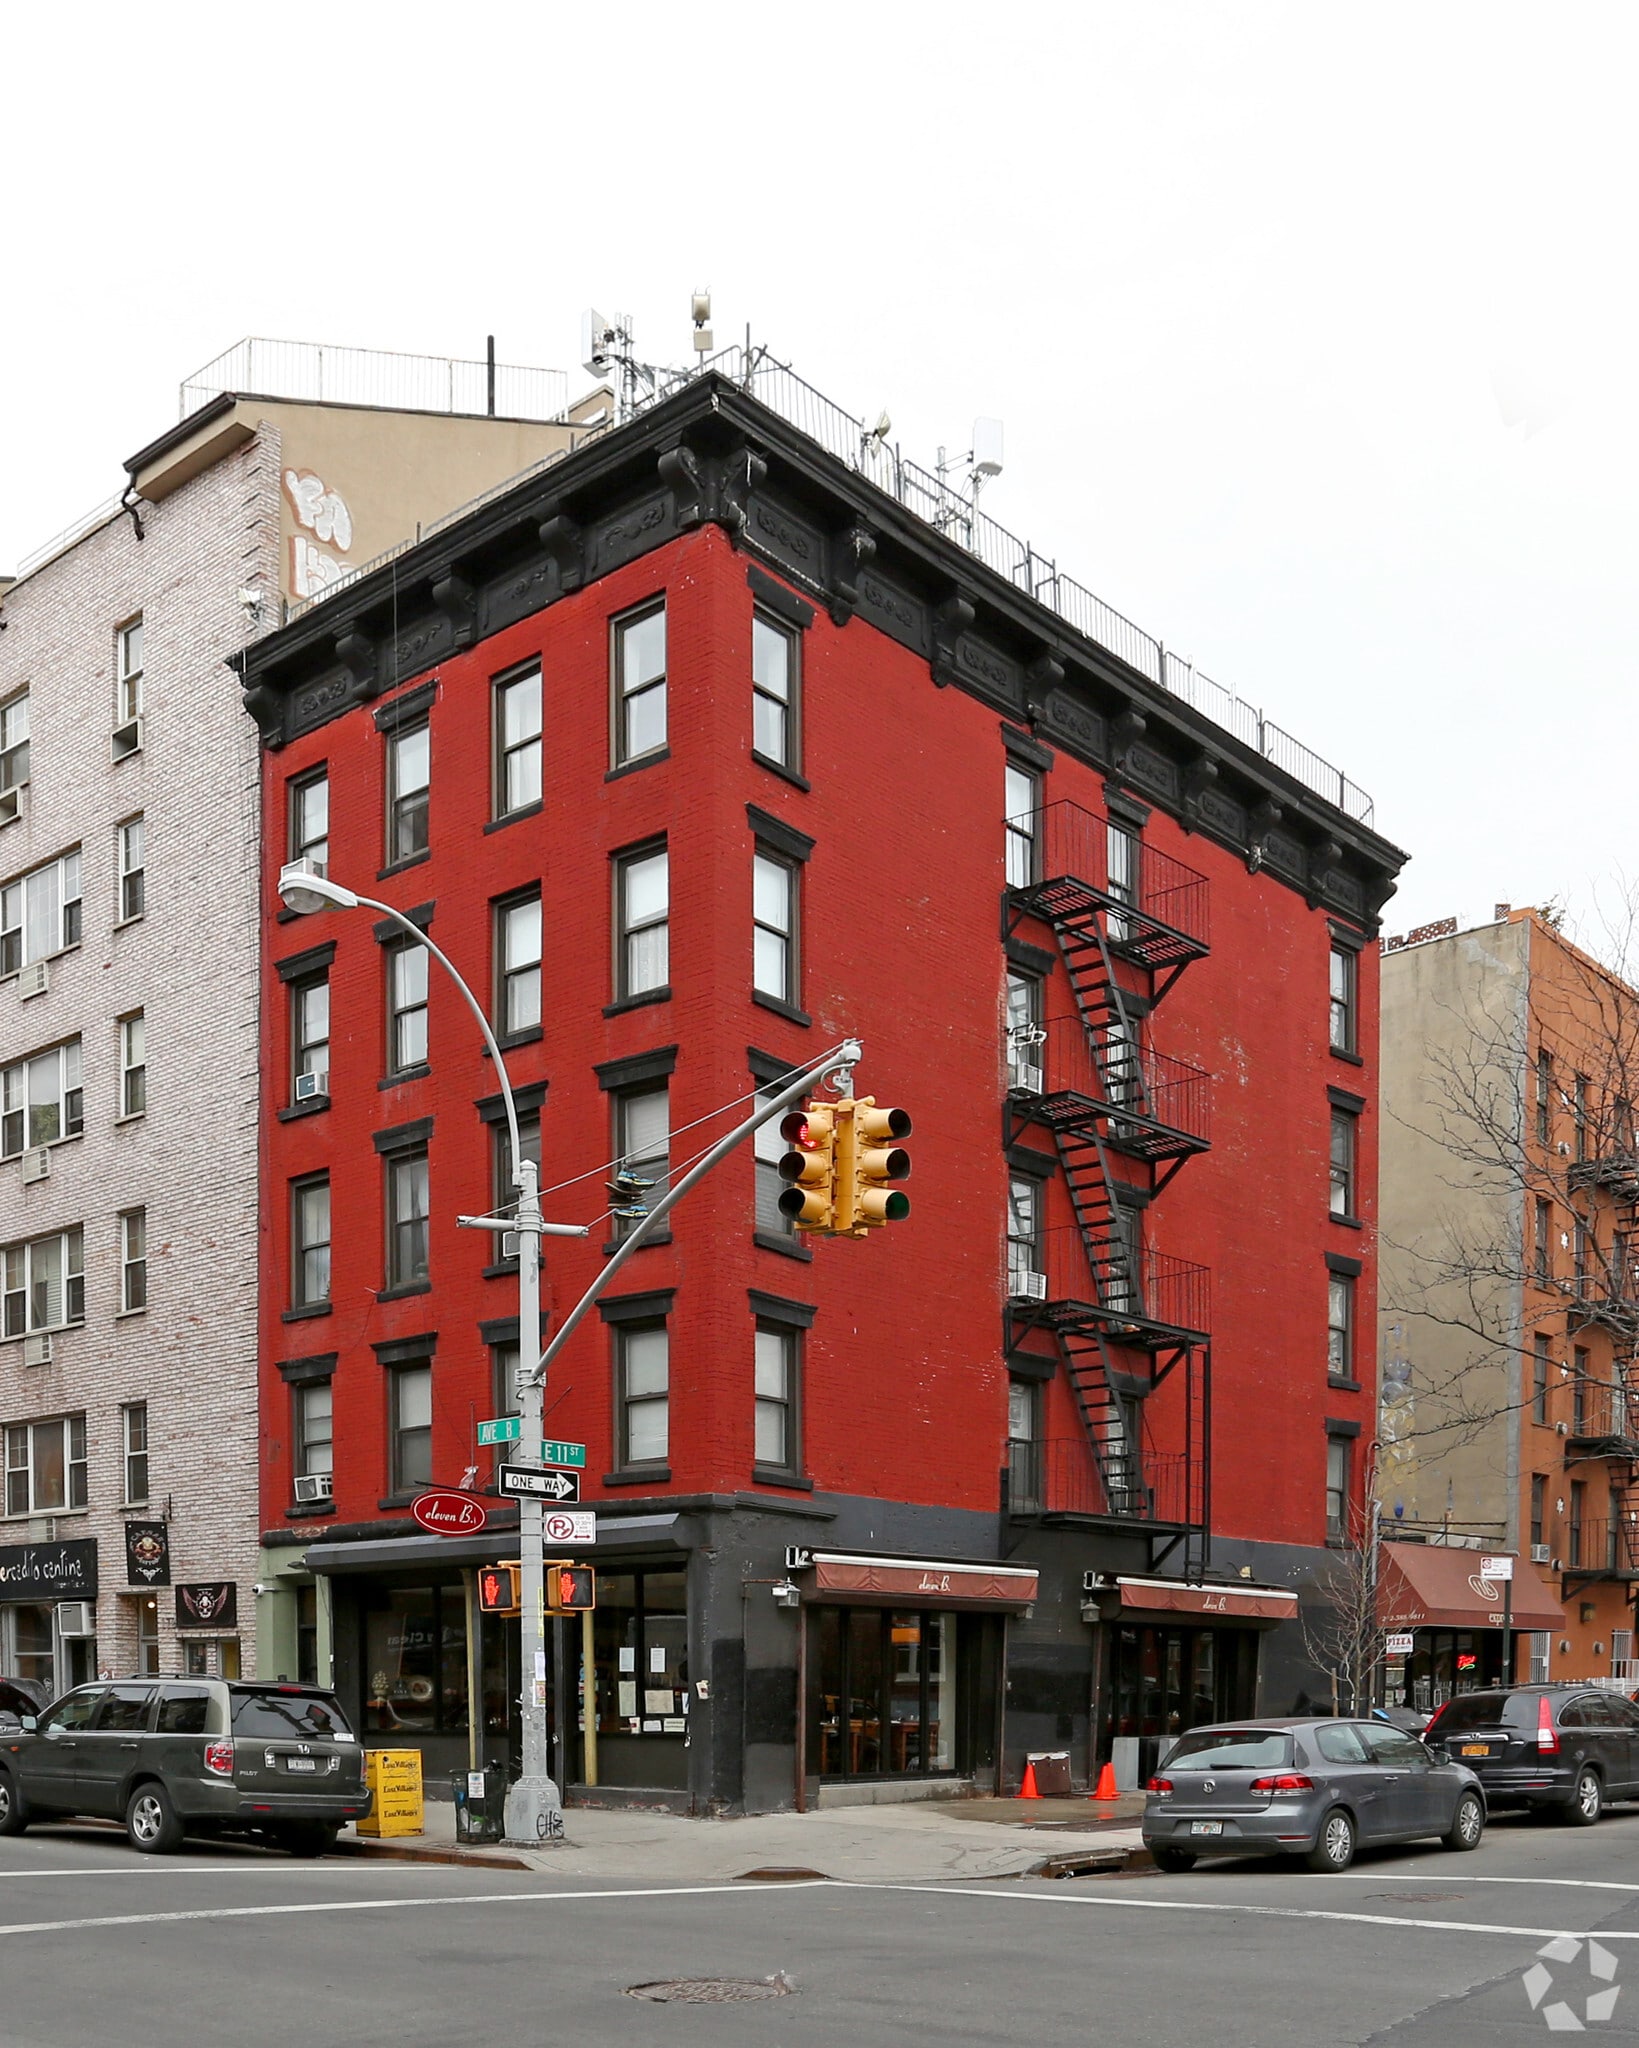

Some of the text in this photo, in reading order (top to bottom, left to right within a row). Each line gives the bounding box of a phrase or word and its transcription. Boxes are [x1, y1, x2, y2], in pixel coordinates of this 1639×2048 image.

[482, 1421, 513, 1442] AVE B
[544, 1444, 553, 1461] E
[511, 1475, 567, 1492] ONE WAY
[425, 1501, 457, 1522] eleven
[0, 1549, 83, 1582] ercadito cantina
[1387, 1638, 1412, 1646] PIZZA
